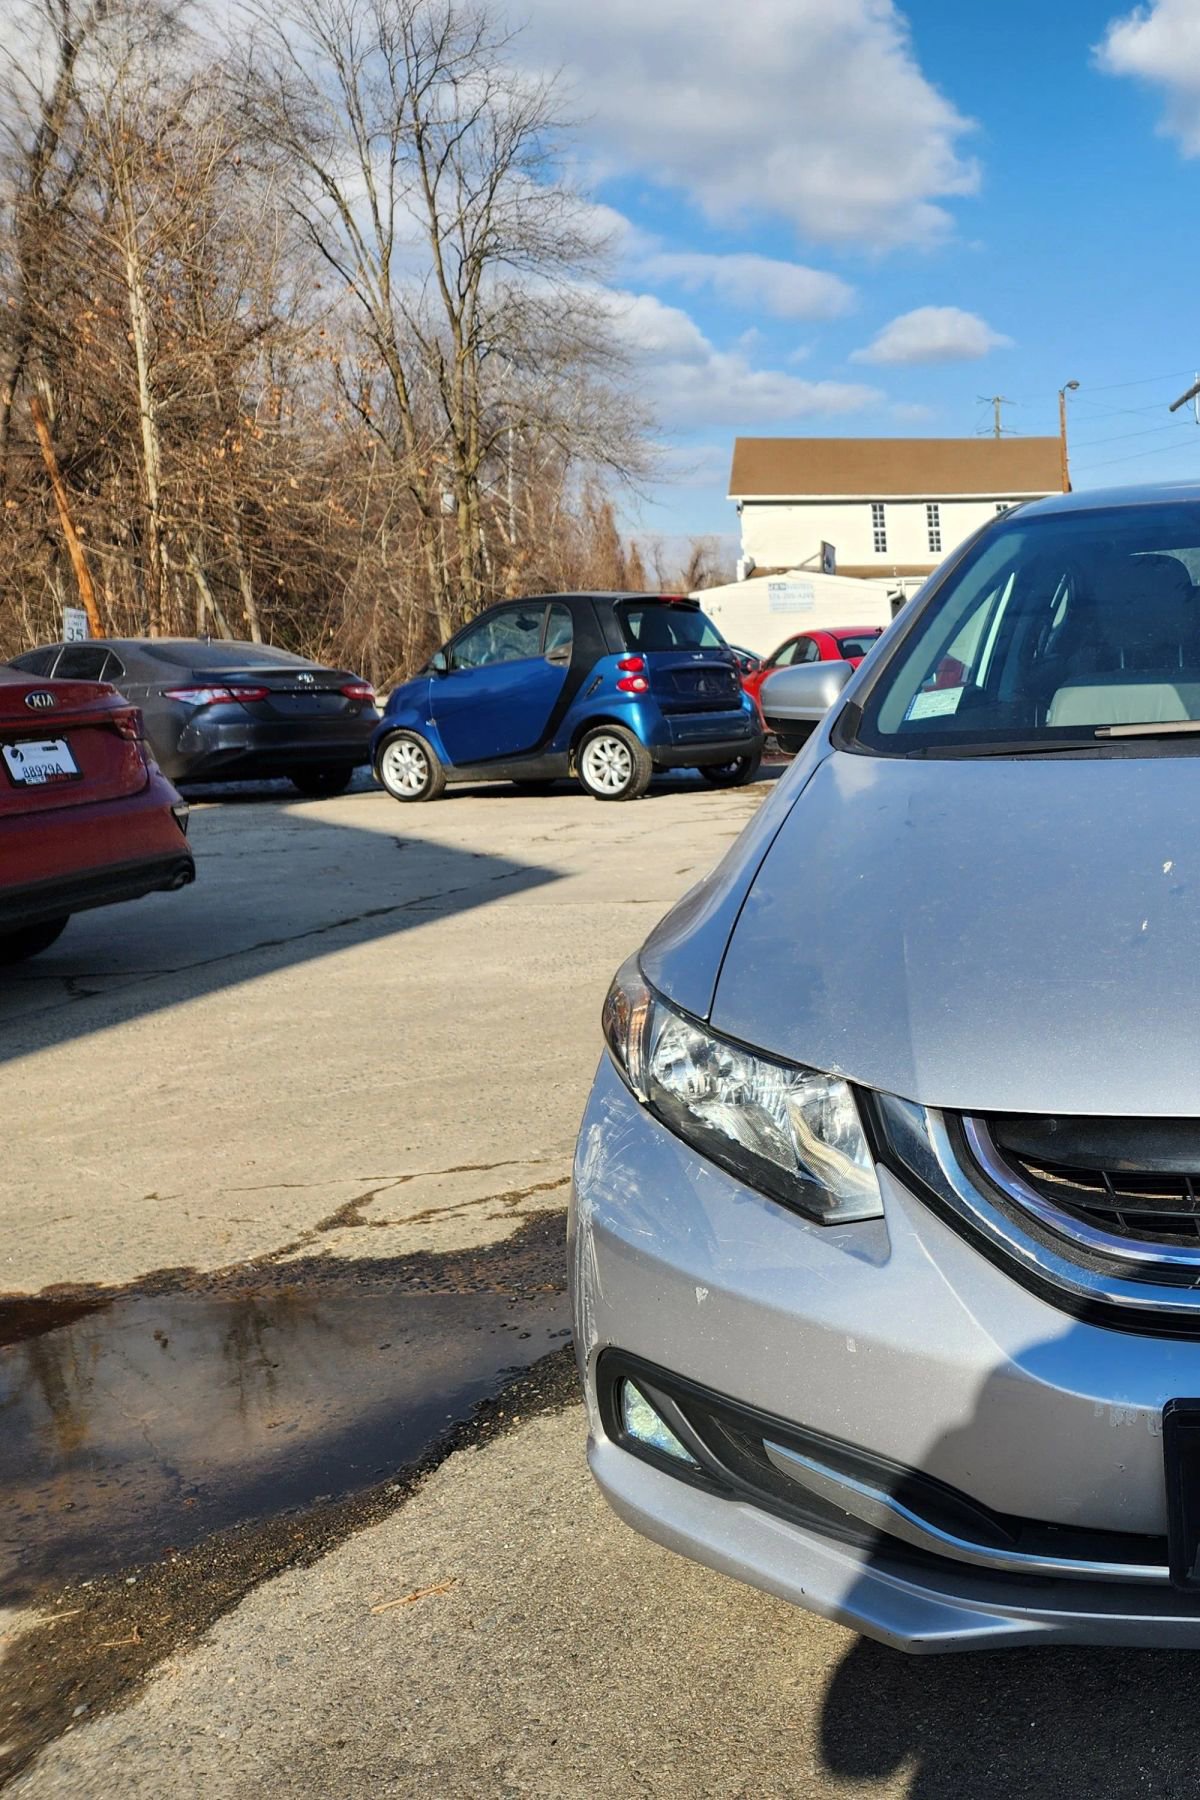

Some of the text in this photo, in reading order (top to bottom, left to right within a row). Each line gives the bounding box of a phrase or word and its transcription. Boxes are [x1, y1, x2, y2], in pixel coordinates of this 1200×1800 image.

[66, 626, 84, 641] 35
[32, 694, 54, 708] KIA
[22, 762, 64, 779] 88929A
